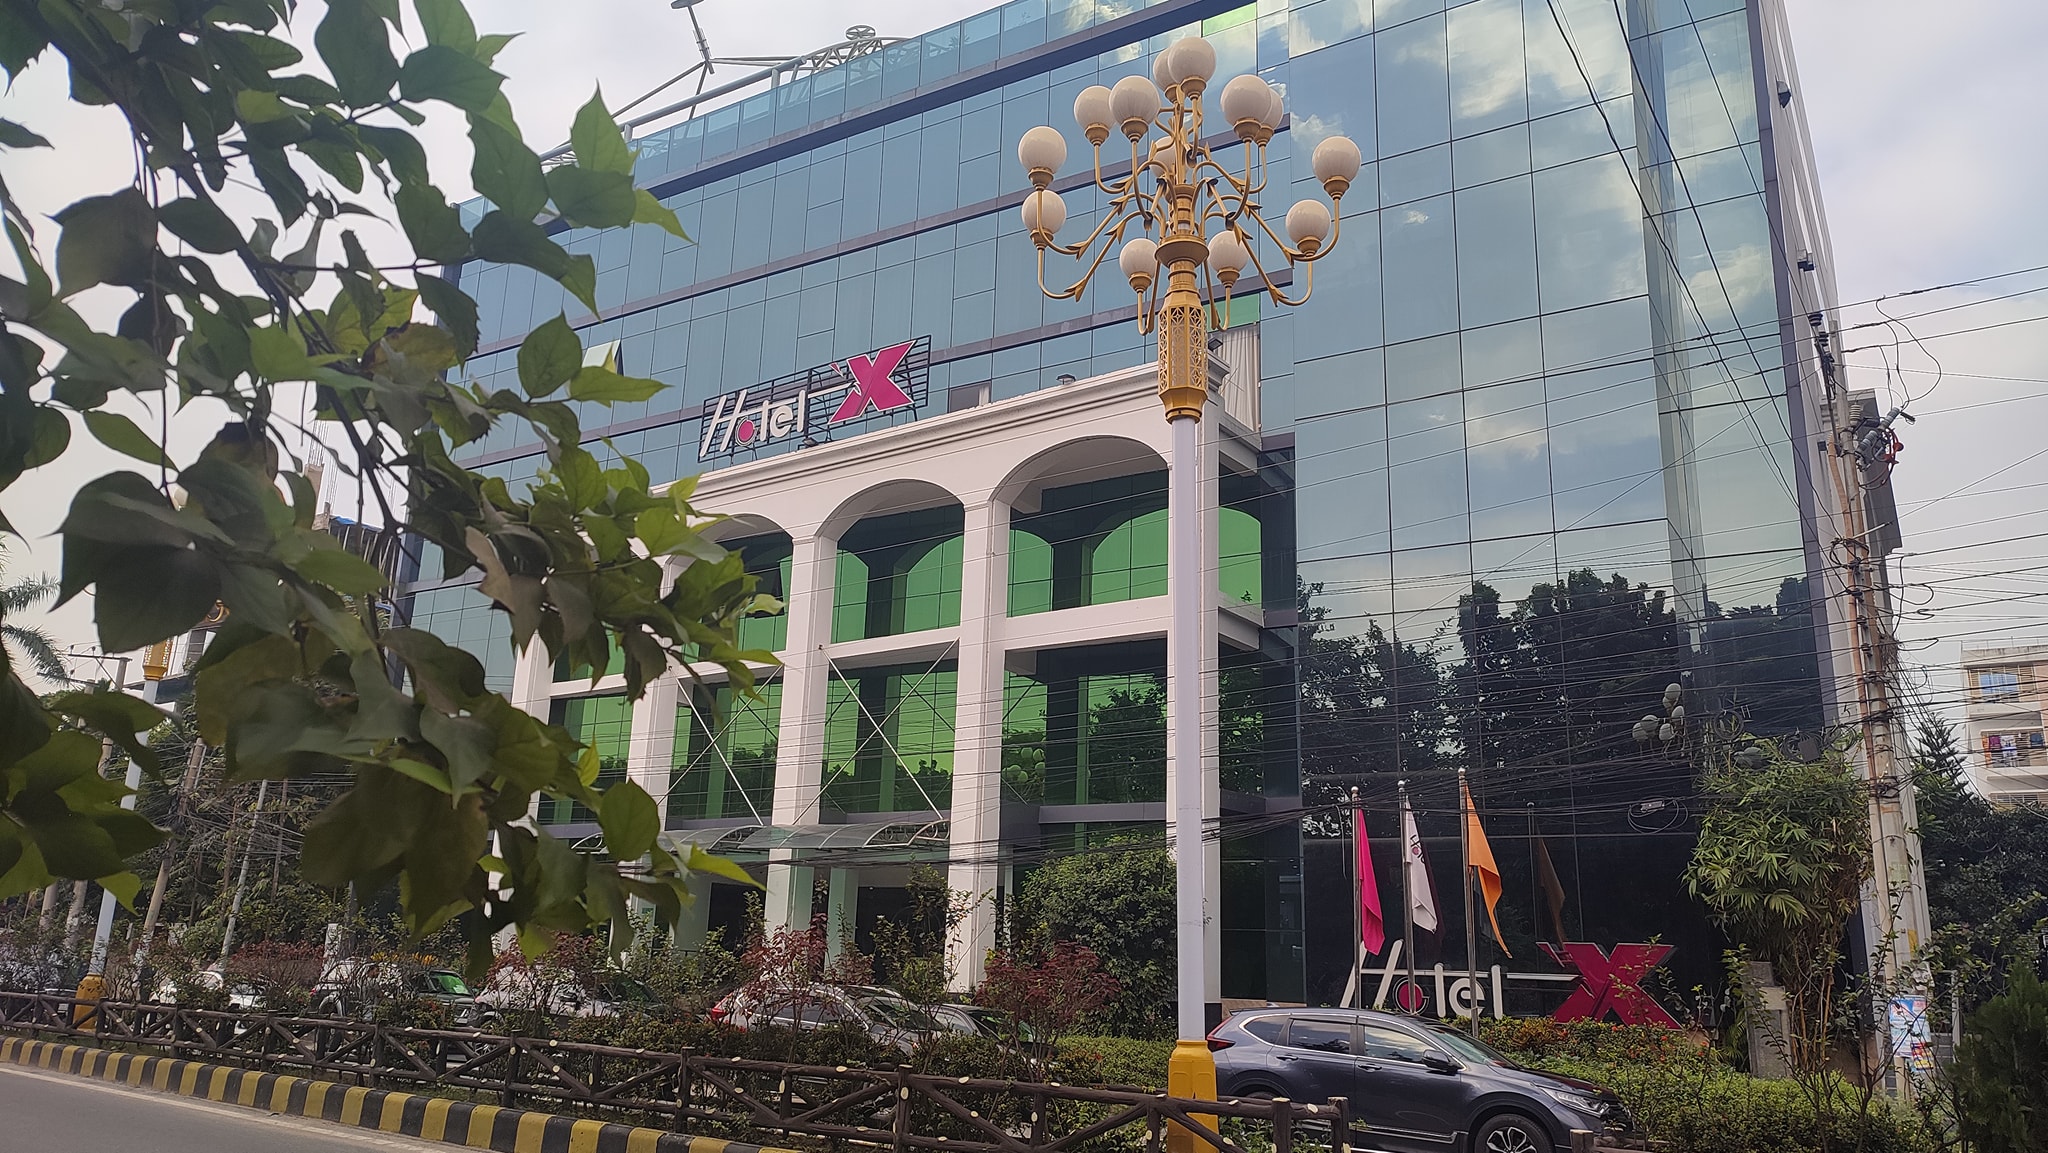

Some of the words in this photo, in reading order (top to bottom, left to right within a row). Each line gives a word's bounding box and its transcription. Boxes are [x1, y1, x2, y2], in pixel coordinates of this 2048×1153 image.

[700, 389, 806, 457] Hotel
[828, 340, 916, 424] X
[1339, 938, 1502, 1019] Hotel
[1536, 941, 1682, 1030] X
